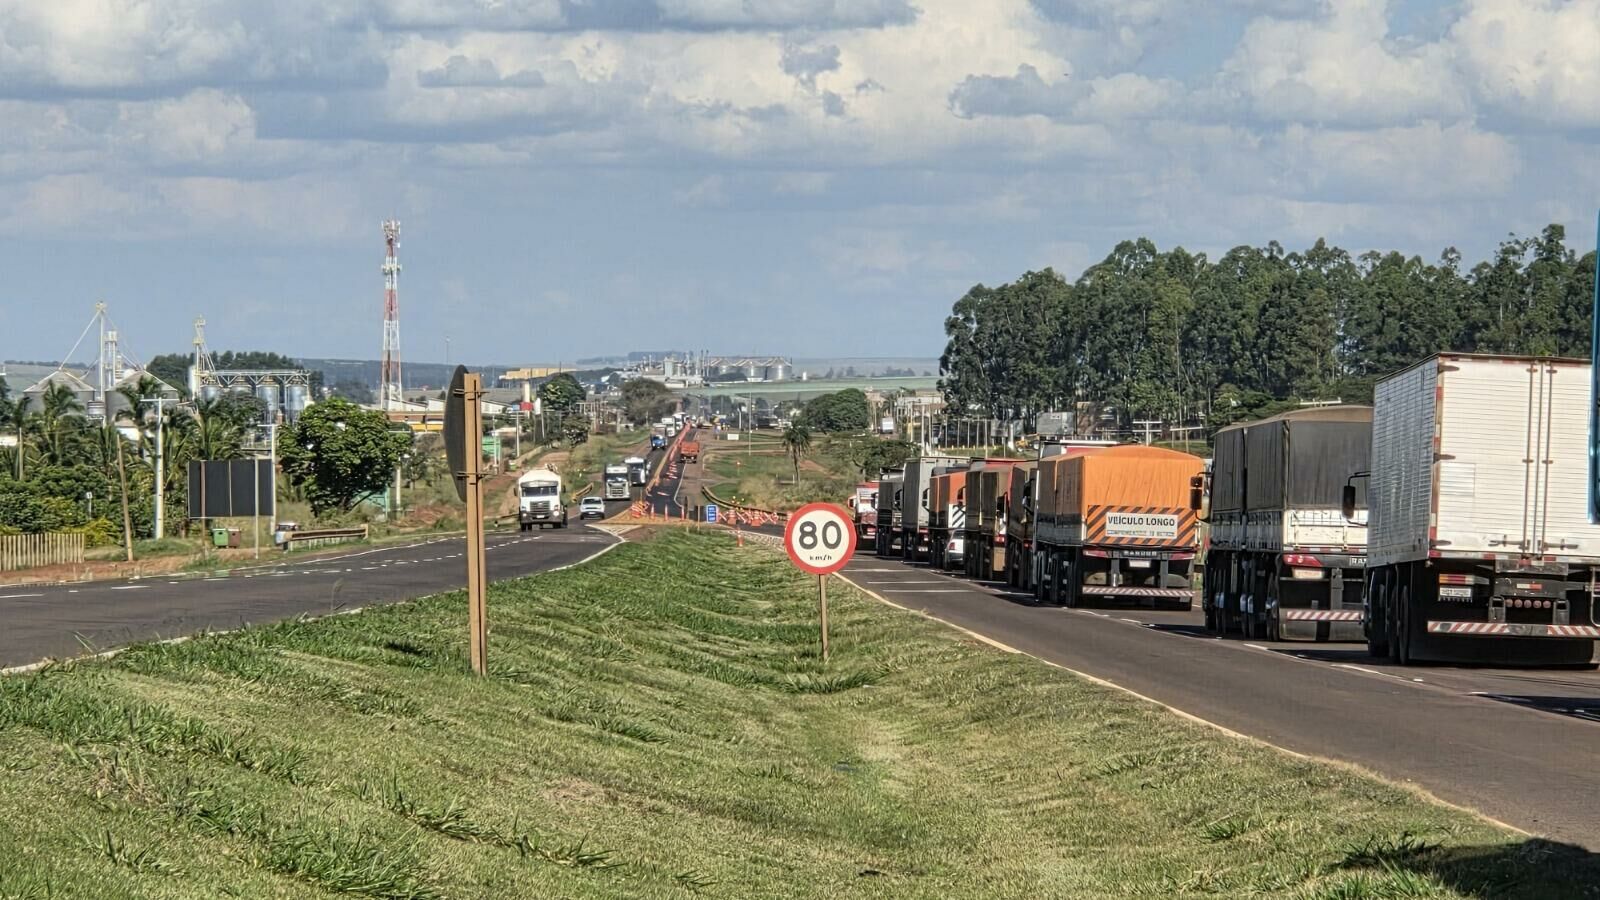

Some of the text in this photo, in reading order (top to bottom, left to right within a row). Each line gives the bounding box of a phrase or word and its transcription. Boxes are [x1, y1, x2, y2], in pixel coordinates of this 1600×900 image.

[1108, 516, 1175, 526] VEÍCULO LONGO
[799, 520, 842, 549] 80
